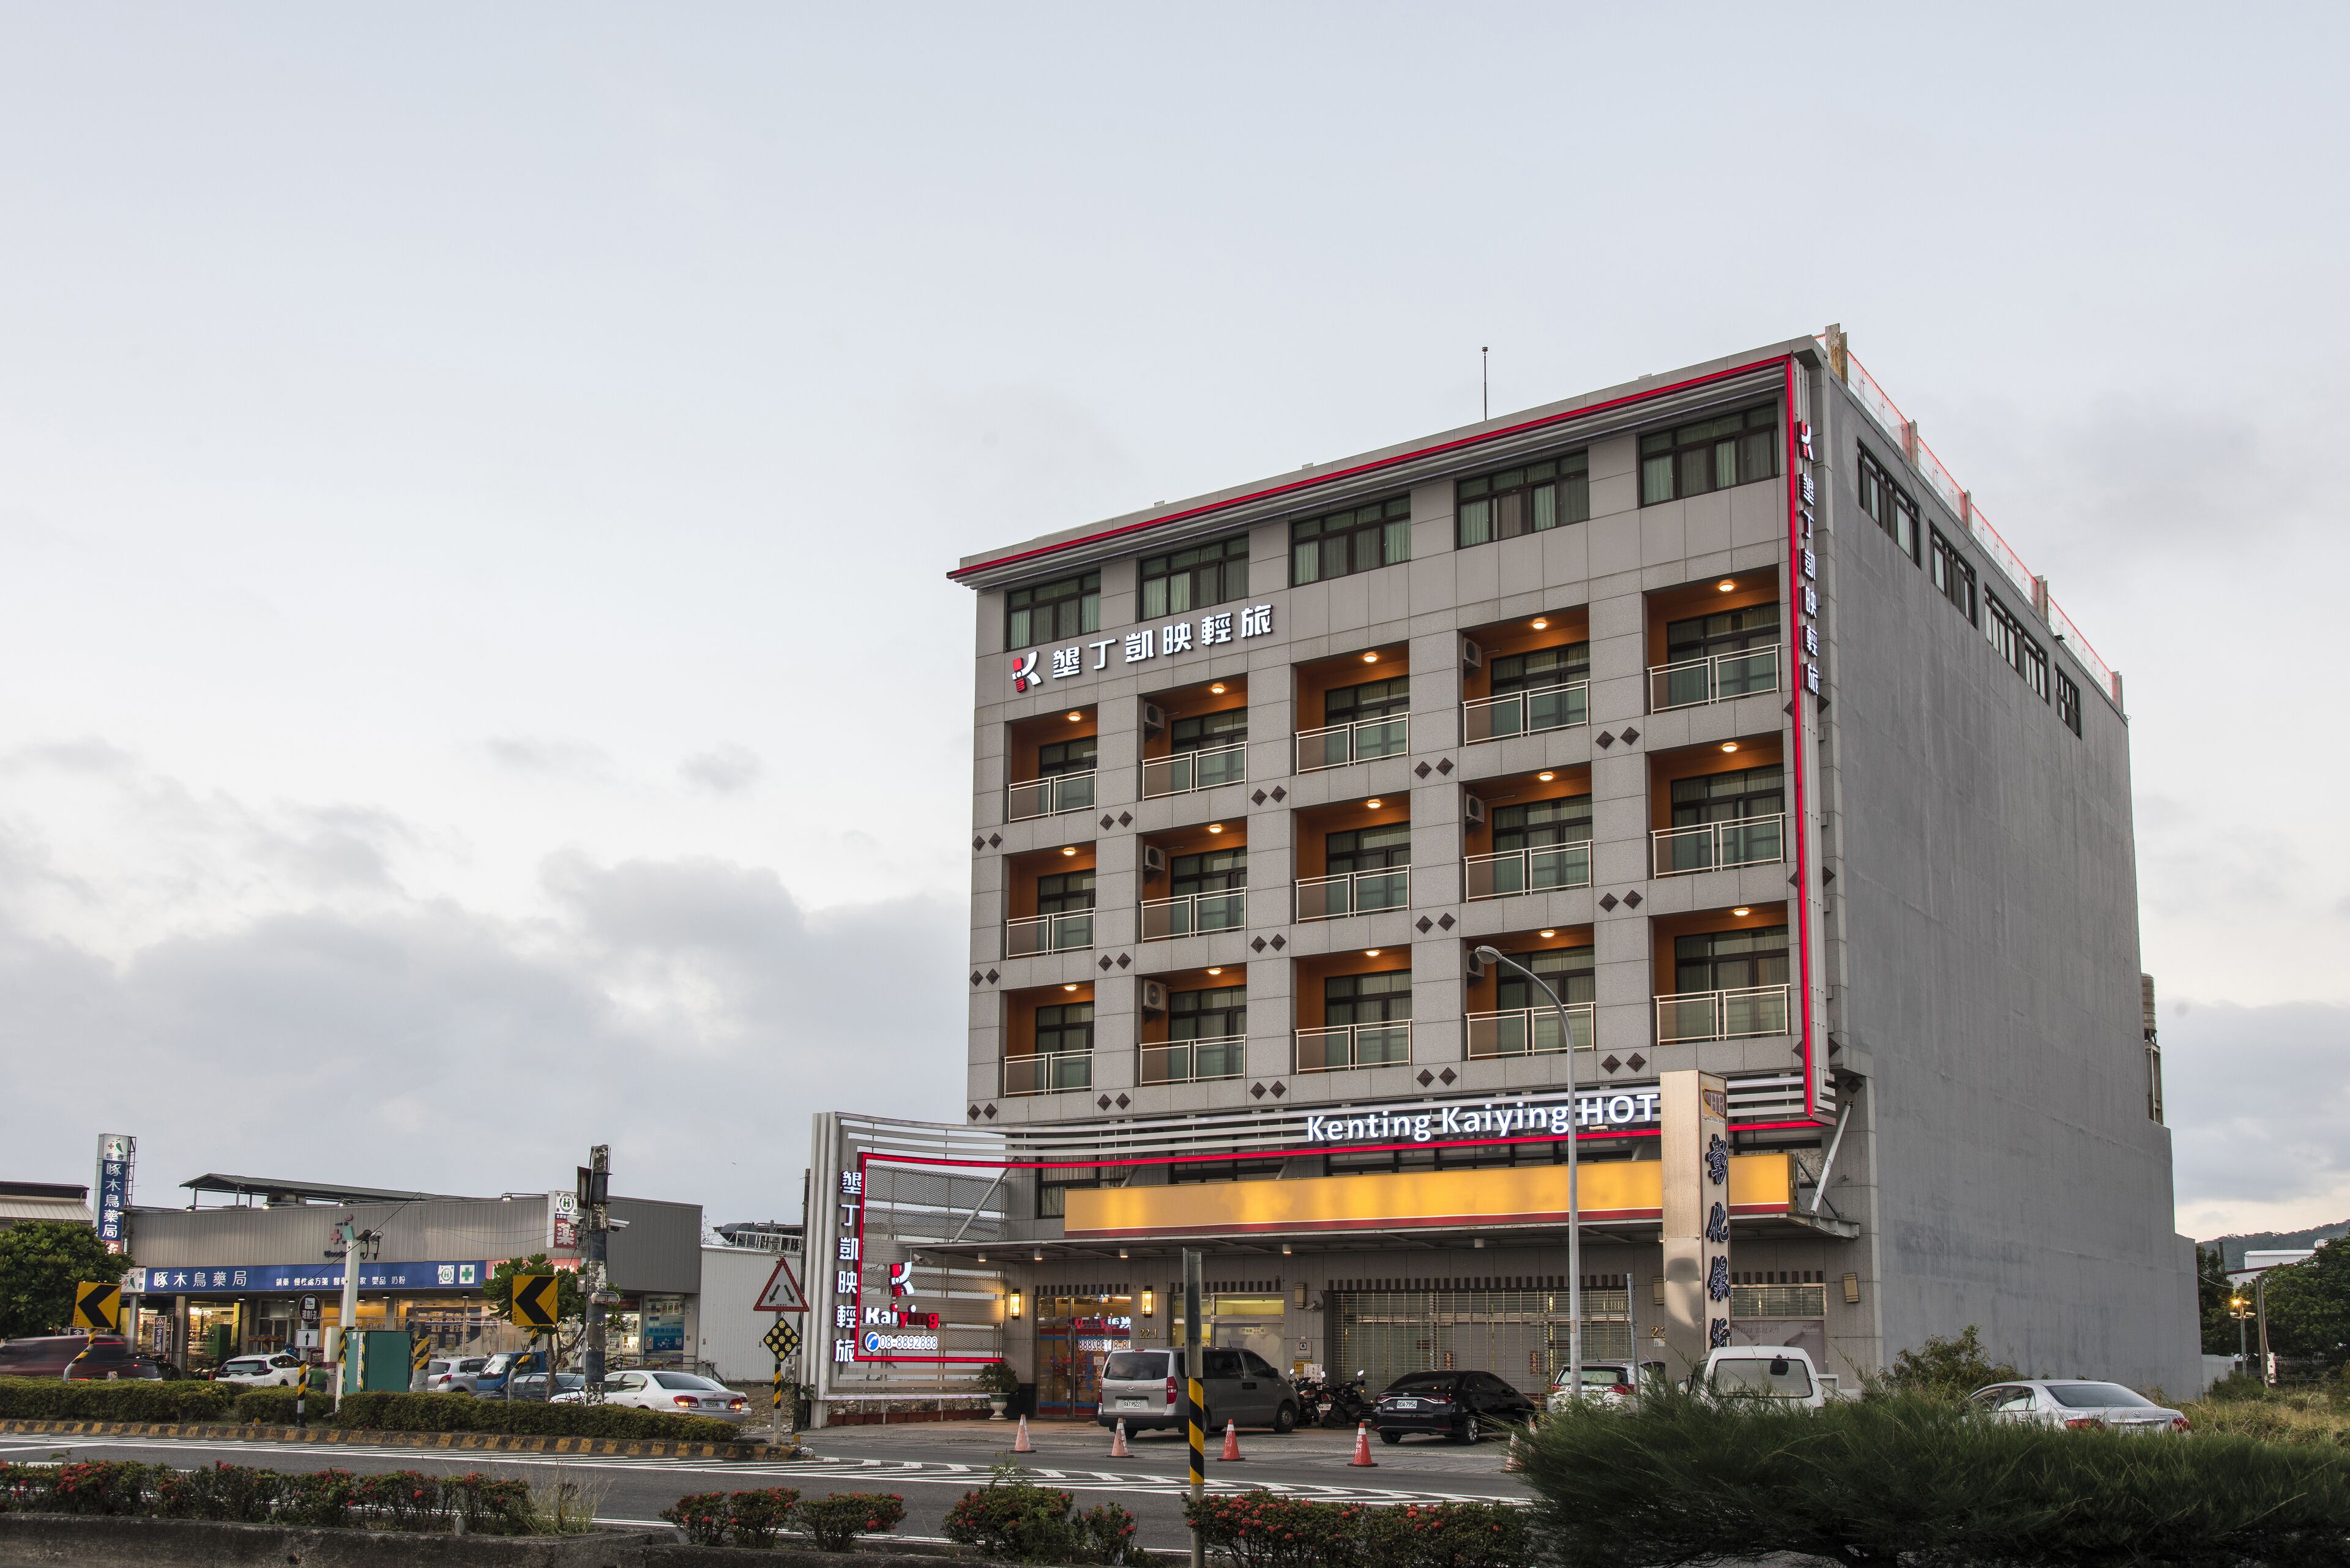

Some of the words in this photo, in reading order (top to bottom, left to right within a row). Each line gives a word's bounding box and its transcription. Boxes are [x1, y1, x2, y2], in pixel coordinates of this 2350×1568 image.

[1799, 472, 1819, 696] 墾丁凱映輕旅
[1052, 603, 1274, 679] 墾丁凱映輕旅
[1307, 1110, 1432, 1141] Kenting
[1442, 1102, 1569, 1137] Kaiying
[102, 1163, 122, 1238] 啄木鳥藥局
[1706, 1133, 1731, 1348] 彰化銀行
[154, 1271, 246, 1288] 啄木鳥藥局
[357, 1276, 367, 1285] 妝
[391, 1275, 406, 1285] 奶粉
[834, 1170, 862, 1362] 墾丁凱映輕旅
[864, 1304, 939, 1329] Kaiying
[1140, 1328, 1158, 1338] 22-1
[879, 1336, 938, 1350] 08-8892888
